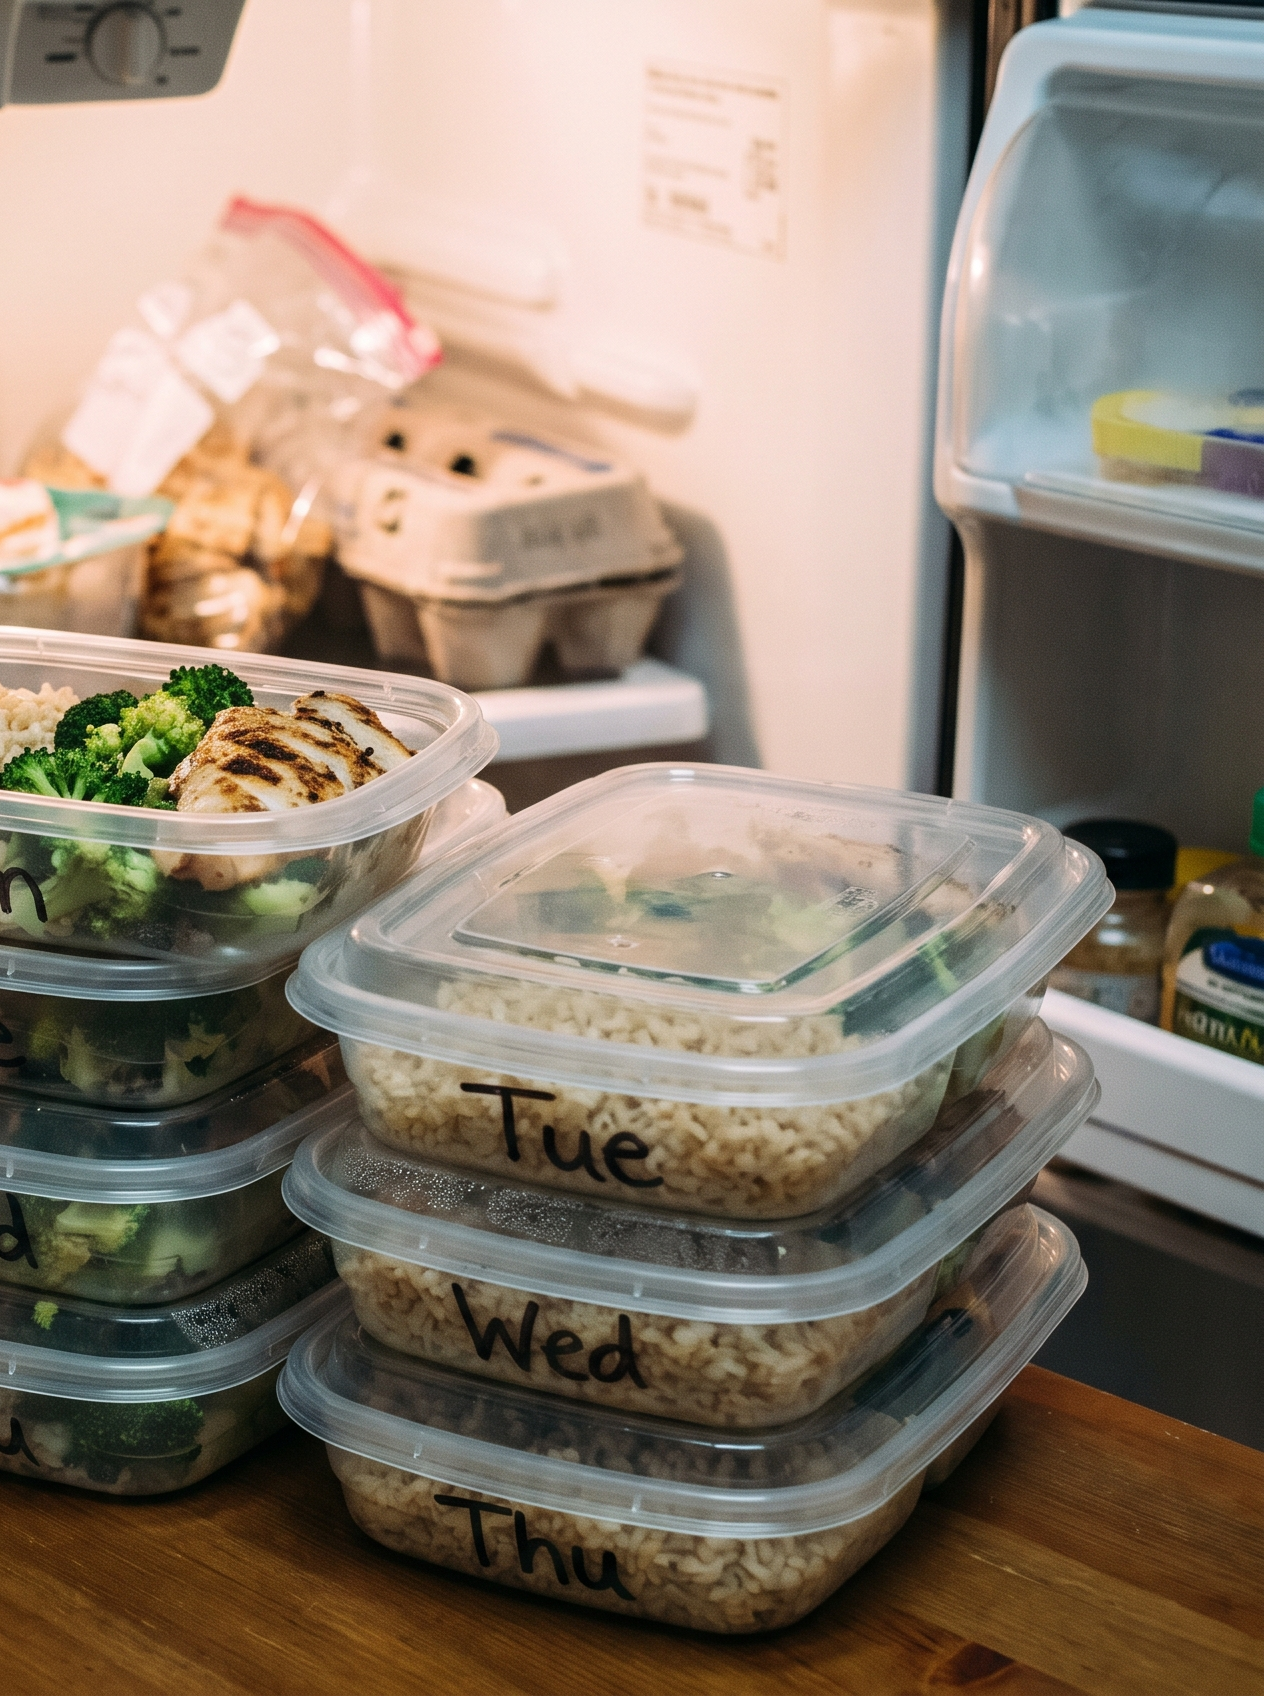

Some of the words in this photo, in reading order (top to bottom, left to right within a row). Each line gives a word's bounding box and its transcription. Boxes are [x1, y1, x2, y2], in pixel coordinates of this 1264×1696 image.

[460, 1082, 664, 1188] Tue
[452, 1283, 648, 1389] Wed
[434, 1494, 636, 1600] Thu
